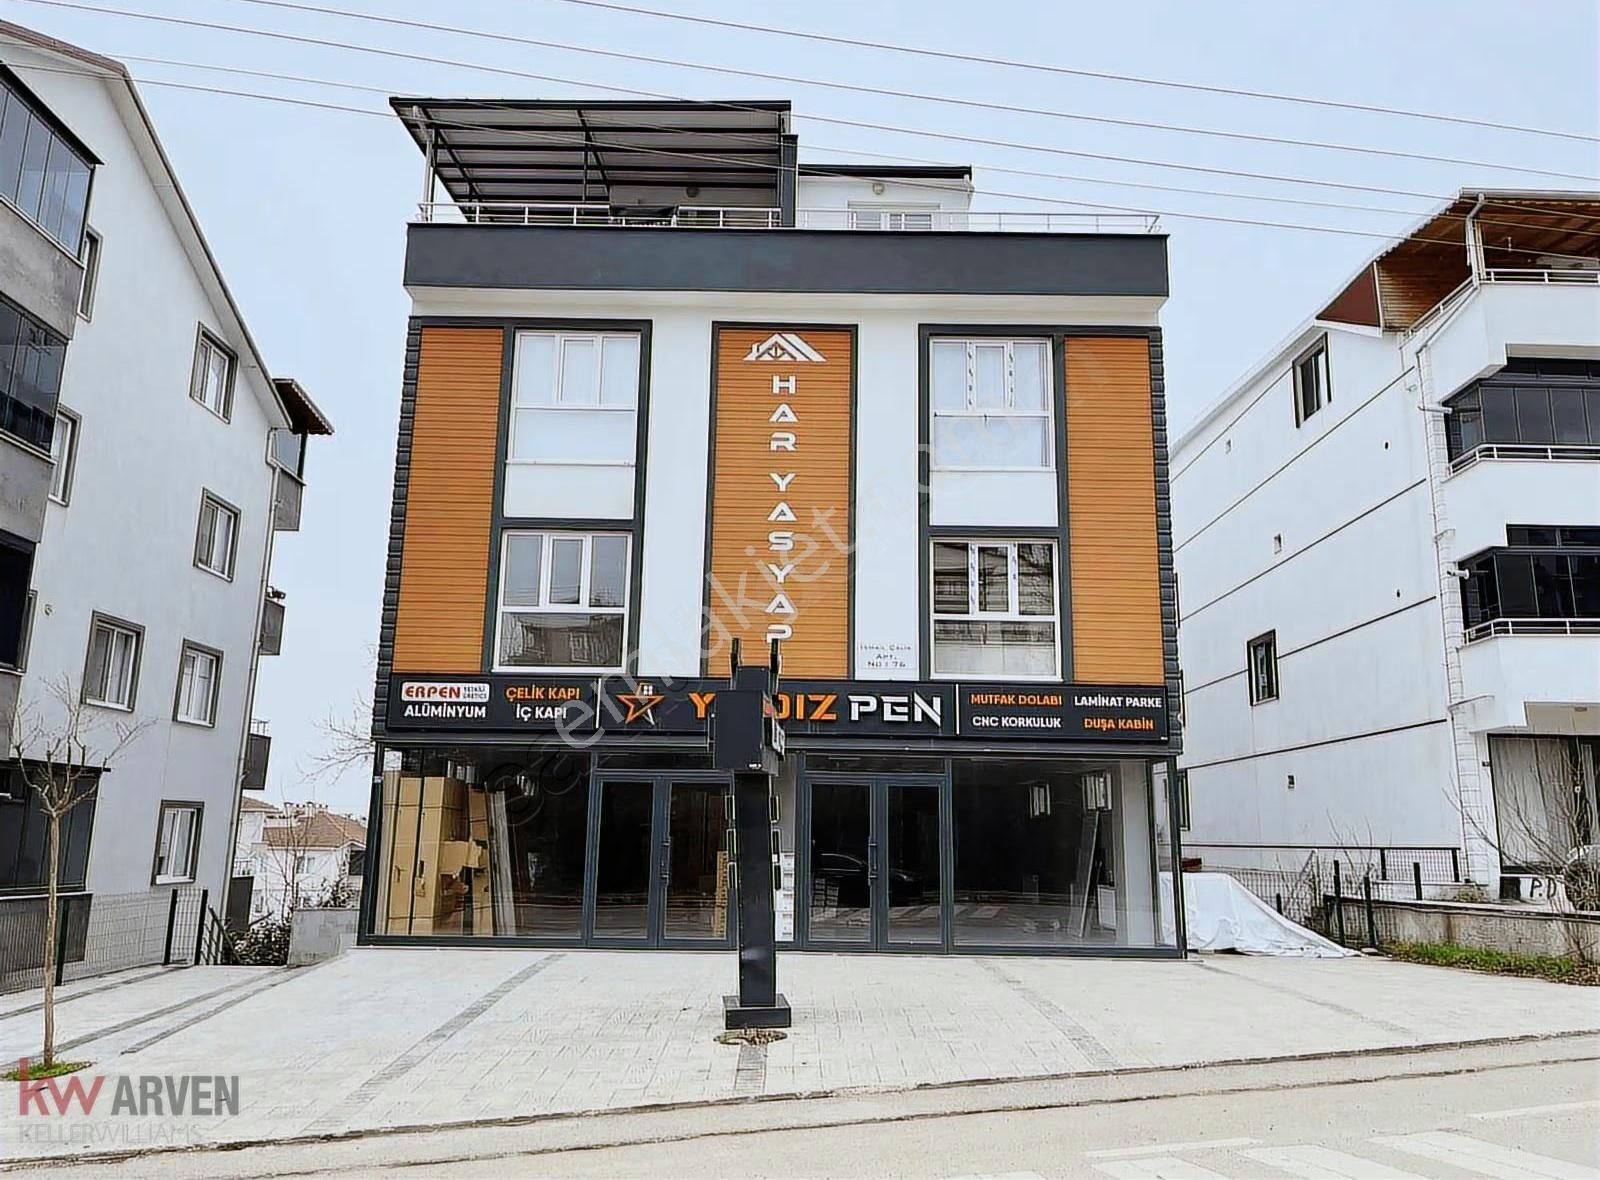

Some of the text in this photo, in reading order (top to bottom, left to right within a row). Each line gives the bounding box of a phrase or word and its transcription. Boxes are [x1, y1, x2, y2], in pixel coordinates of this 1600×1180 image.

[767, 374, 800, 452] HAR
[405, 685, 461, 699] ERPEN
[505, 683, 580, 702] ÇELİK KAPI
[970, 693, 1062, 706] MUTFAK DOLABI
[1073, 693, 1163, 708] LAMİNAT PARKE
[403, 702, 487, 718] ALÜMİNYUM
[516, 703, 567, 722] İÇ KAPI
[687, 690, 942, 728] YDIZ PEN
[972, 715, 1062, 728] CNC KORKULUK
[1084, 716, 1154, 732] DUŞA KABİN
